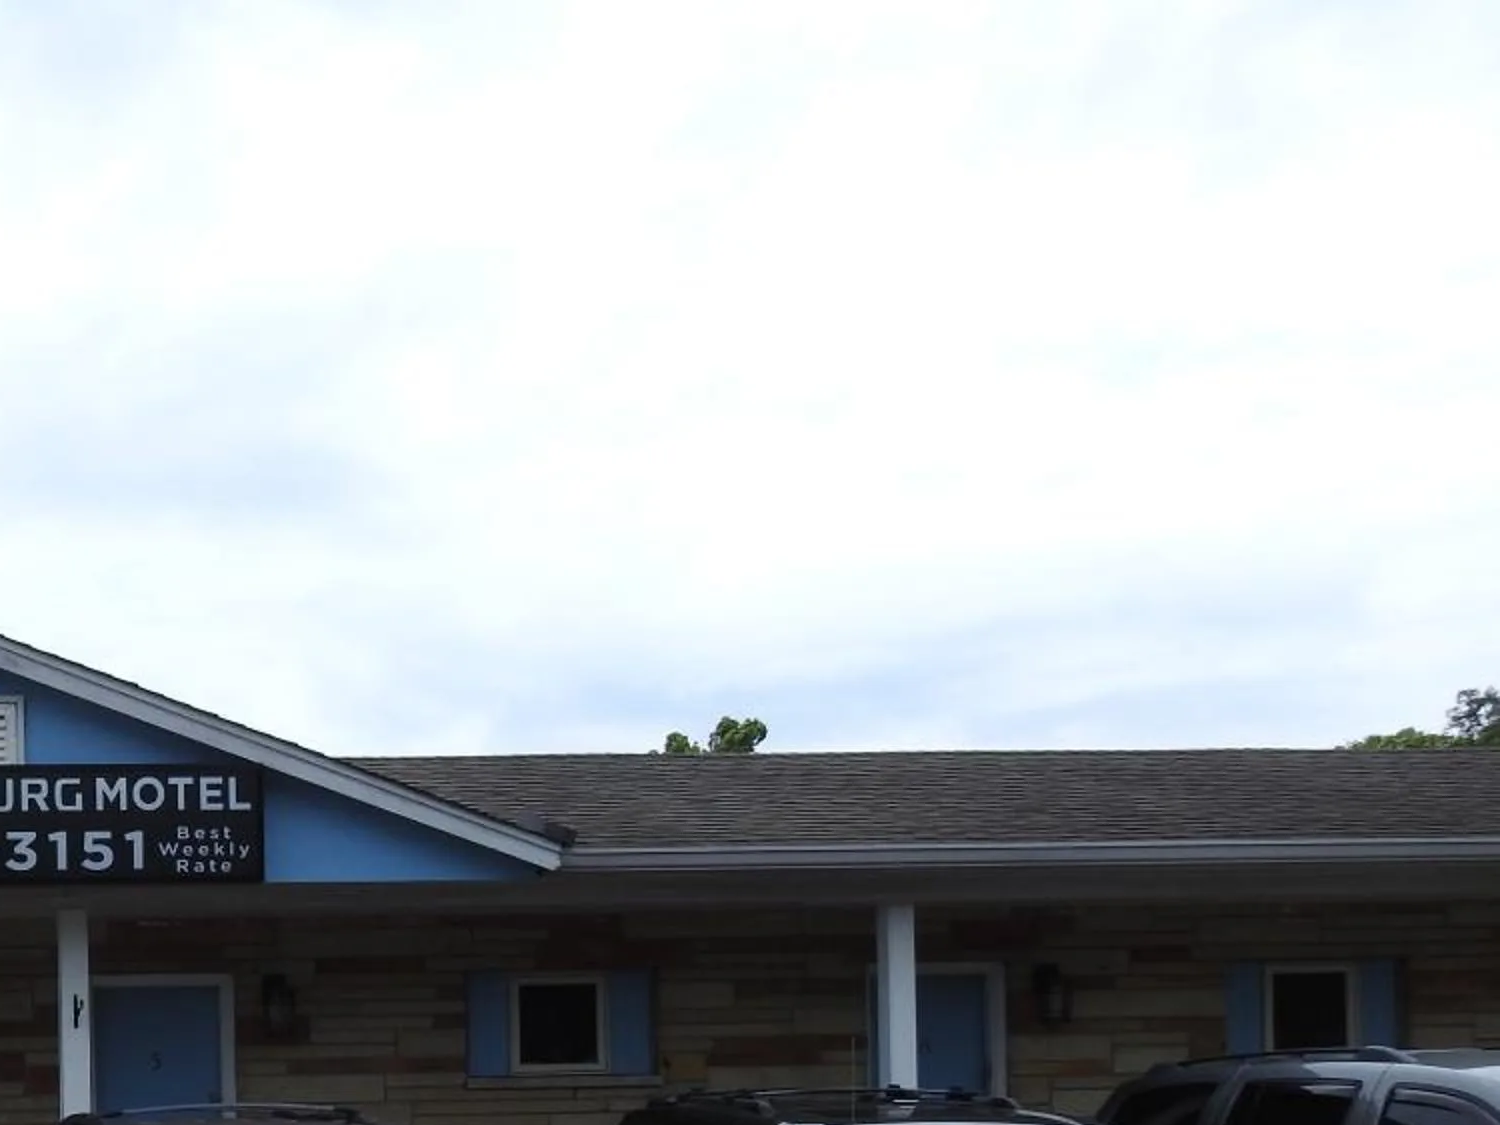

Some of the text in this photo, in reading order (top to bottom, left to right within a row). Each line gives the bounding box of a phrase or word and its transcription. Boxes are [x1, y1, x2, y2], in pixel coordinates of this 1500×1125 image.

[94, 775, 252, 812] MOTEL
[176, 826, 232, 840] Best
[157, 841, 252, 859] Weekly
[175, 858, 233, 874] Rate
